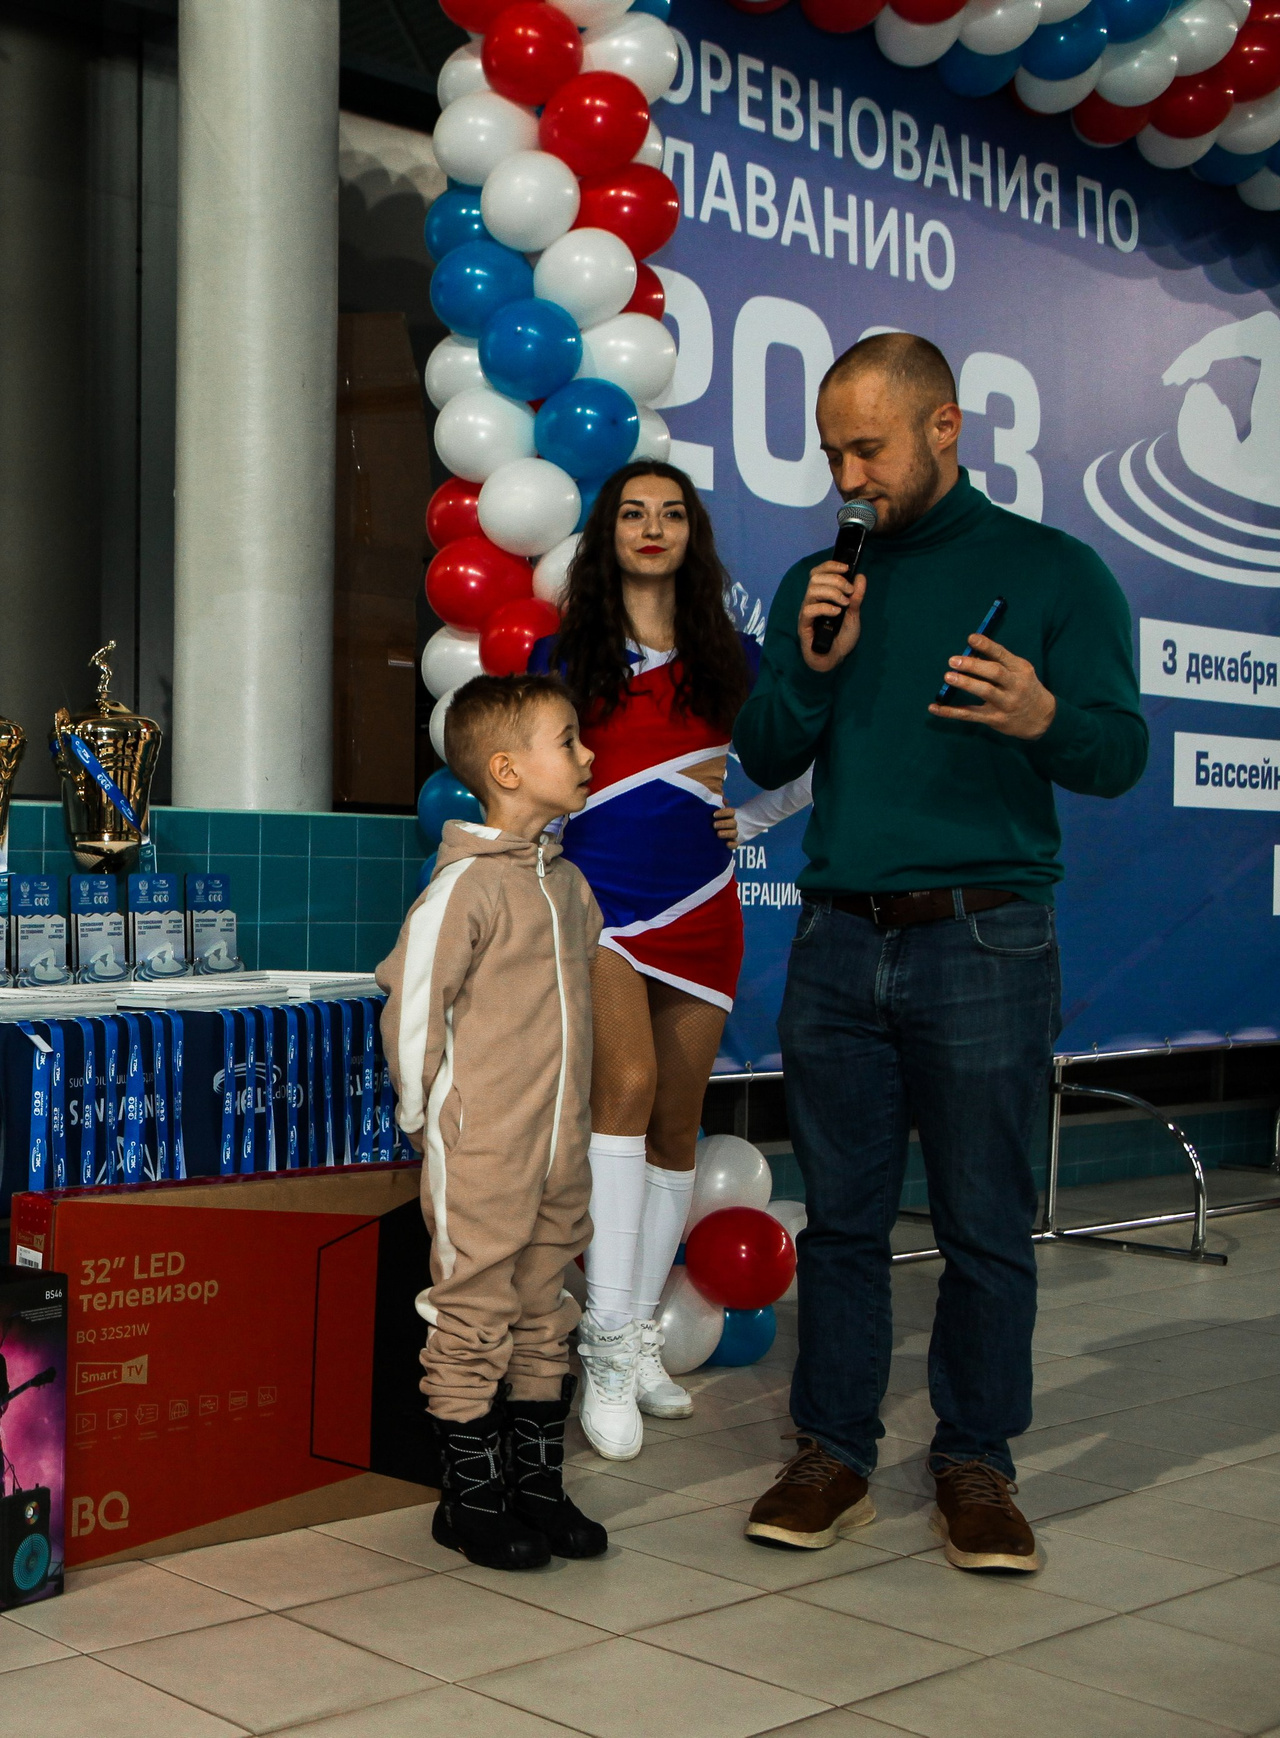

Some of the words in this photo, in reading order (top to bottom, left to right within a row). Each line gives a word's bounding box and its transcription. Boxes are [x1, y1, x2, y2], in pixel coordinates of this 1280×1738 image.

[661, 26, 1060, 230] ОРЕВНОВАНИЯ
[1076, 175, 1139, 253] ПО
[663, 136, 956, 291] ЛАВАНИЮ
[642, 264, 1044, 523] 203
[1162, 639, 1177, 676] 3
[1186, 650, 1278, 695] декабря
[1195, 750, 1280, 790] Бассейн
[732, 845, 767, 870] ТВА
[737, 882, 802, 910] ЕРАЦИИ
[133, 1251, 186, 1280] LED
[45, 1289, 63, 1300] BS46
[79, 1279, 219, 1313] телевизор
[76, 1329, 97, 1344] BQ
[99, 1322, 150, 1341] 32S21W
[81, 1368, 118, 1383] Smart
[127, 1364, 144, 1377] TV
[71, 1490, 130, 1538] BQ
